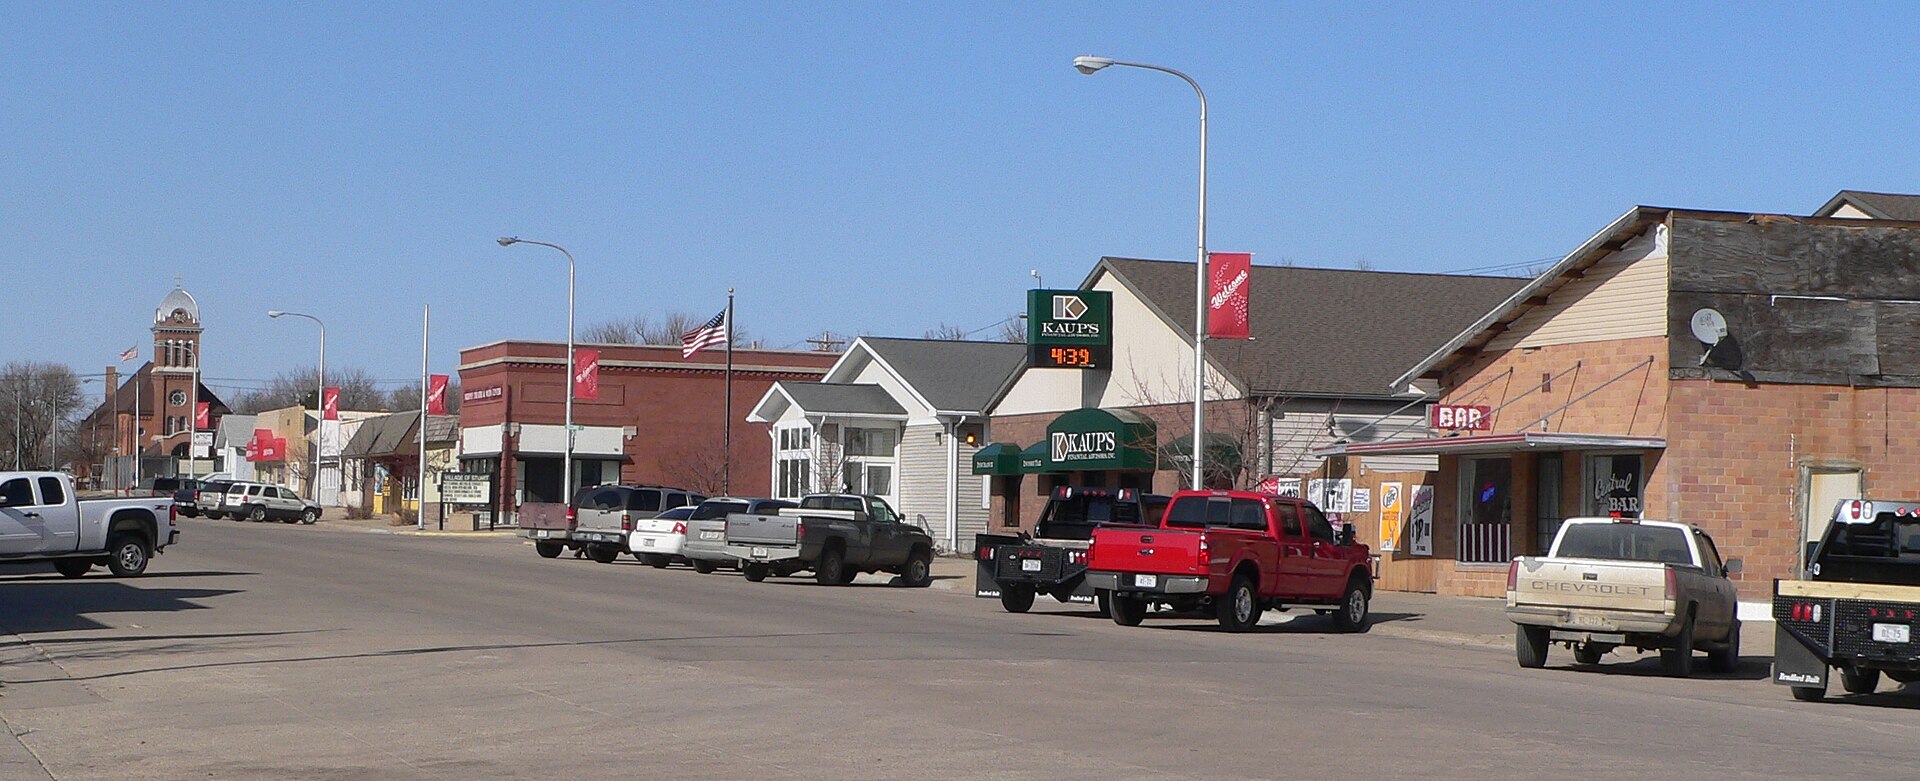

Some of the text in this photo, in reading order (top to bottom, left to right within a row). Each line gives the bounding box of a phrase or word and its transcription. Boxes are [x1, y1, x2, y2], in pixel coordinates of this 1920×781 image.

[1211, 270, 1248, 309] Welcome
[1041, 322, 1099, 334] KAUP'S
[1051, 348, 1089, 365] 4:39
[1439, 407, 1482, 429] BAR
[1068, 432, 1116, 453] KAUP'S
[1595, 473, 1632, 499] Central
[1609, 497, 1639, 512] BAR
[1532, 581, 1650, 595] CHEVROLET
[1779, 672, 1820, 683] Bradford Built
